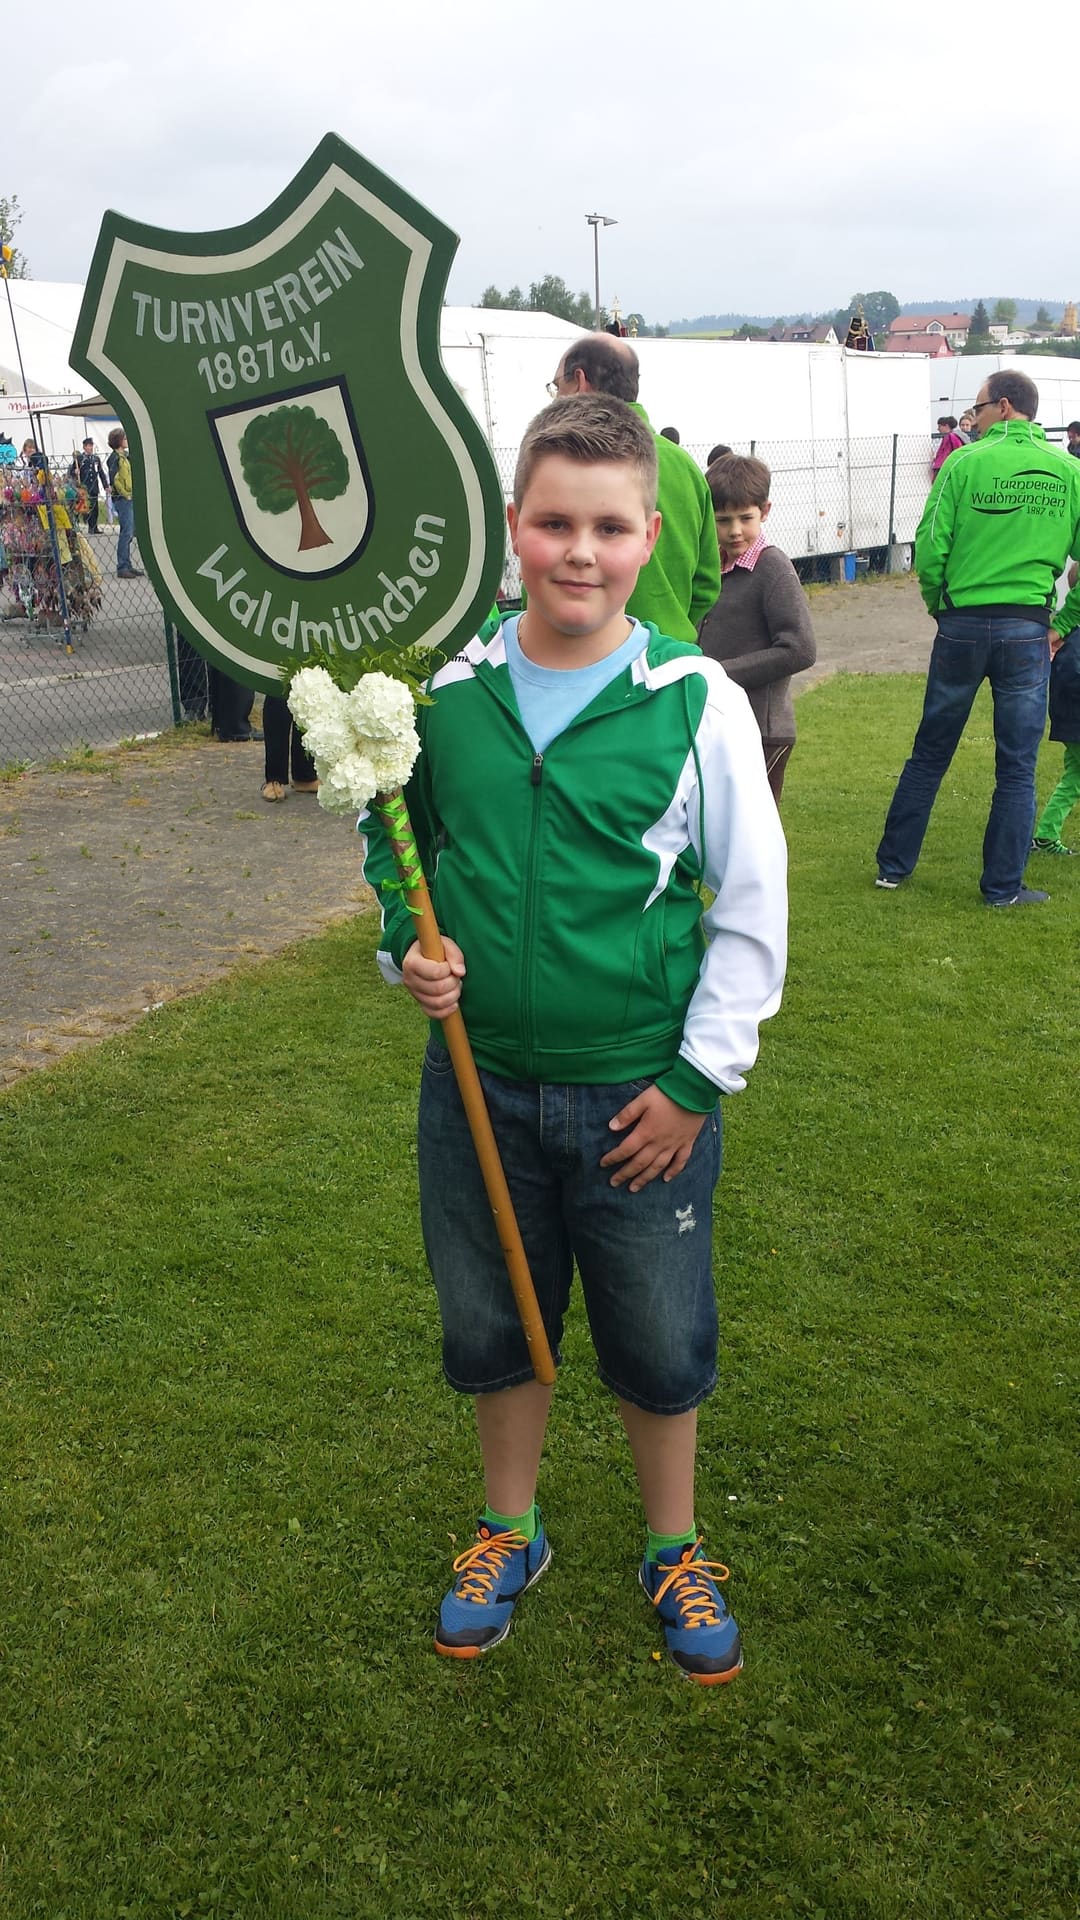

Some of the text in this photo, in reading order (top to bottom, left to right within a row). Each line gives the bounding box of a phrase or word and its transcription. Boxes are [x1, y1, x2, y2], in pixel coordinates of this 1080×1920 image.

[132, 226, 365, 344] TURNVEREIN
[197, 339, 275, 394] 1887
[971, 491, 1066, 508] Waldmünchen
[992, 477, 1067, 494] Turnverein
[1027, 505, 1046, 515] 1887
[196, 513, 446, 655] Waldmünchen
